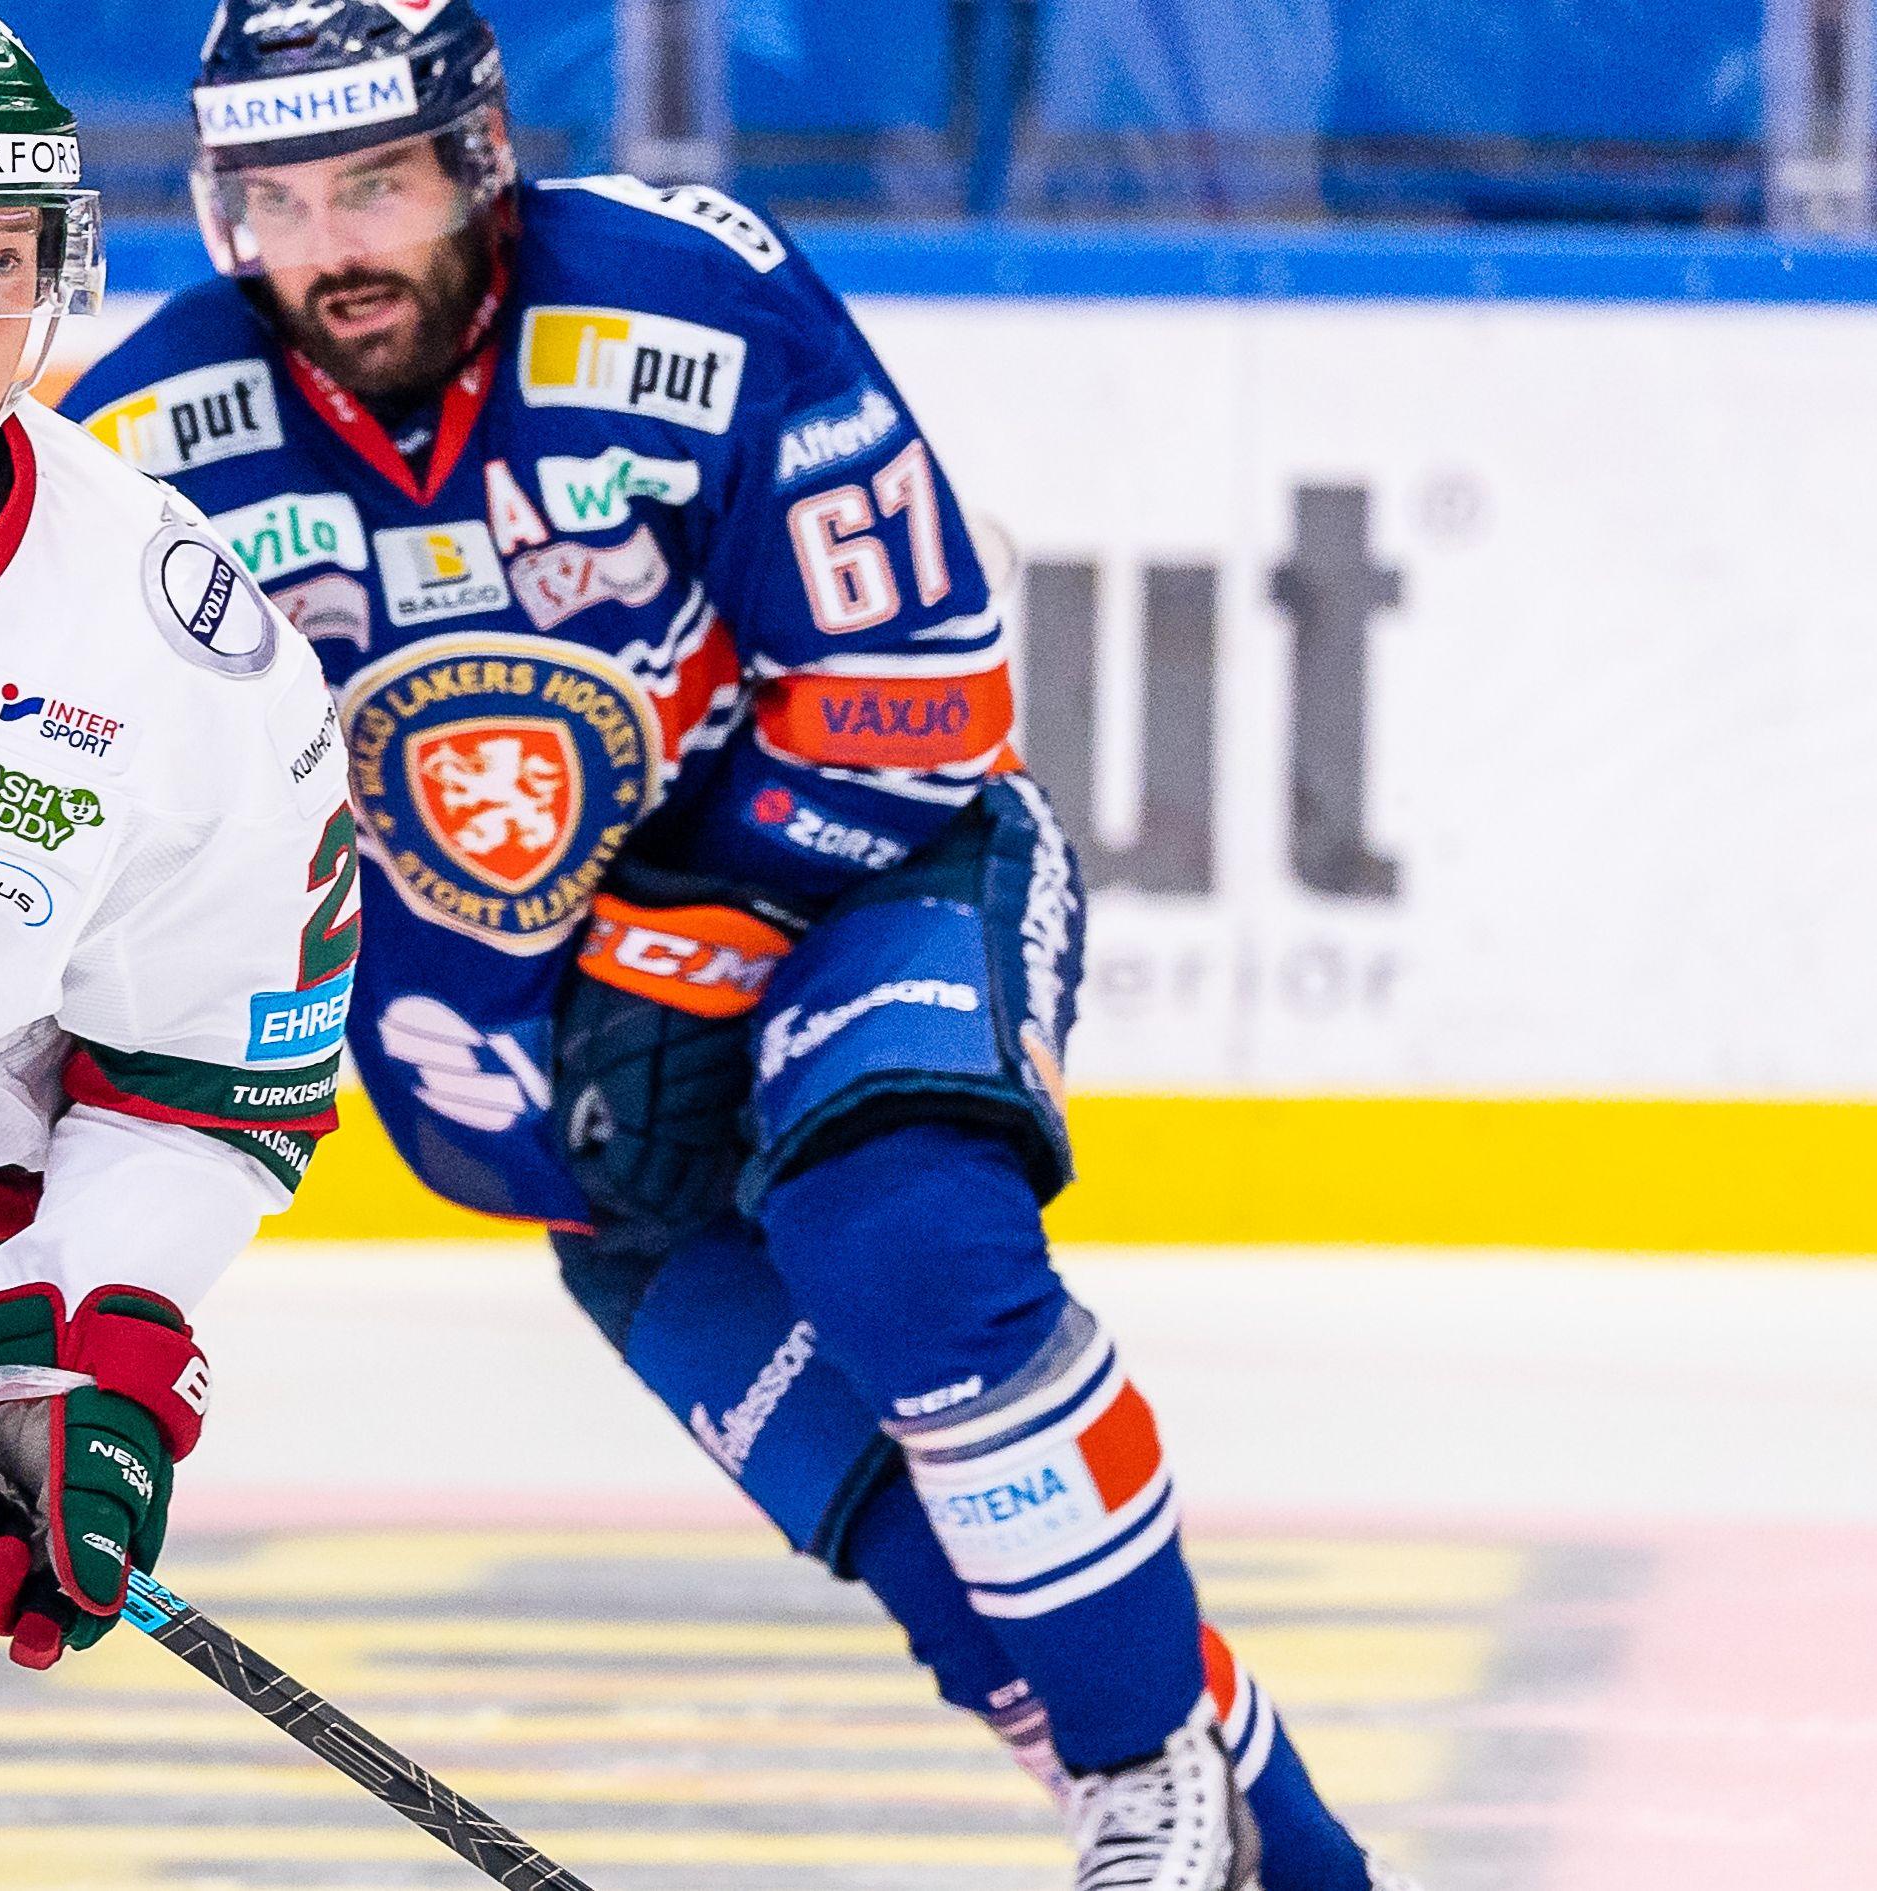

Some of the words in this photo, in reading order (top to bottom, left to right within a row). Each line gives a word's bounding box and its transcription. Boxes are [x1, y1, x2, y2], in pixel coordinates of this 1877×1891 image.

[787, 439, 951, 636] 67
[192, 563, 232, 634] VOLVO
[46, 700, 118, 739] INTER
[1024, 482, 1406, 902] ut
[39, 720, 112, 758] SPORT
[260, 994, 345, 1045] EHRE
